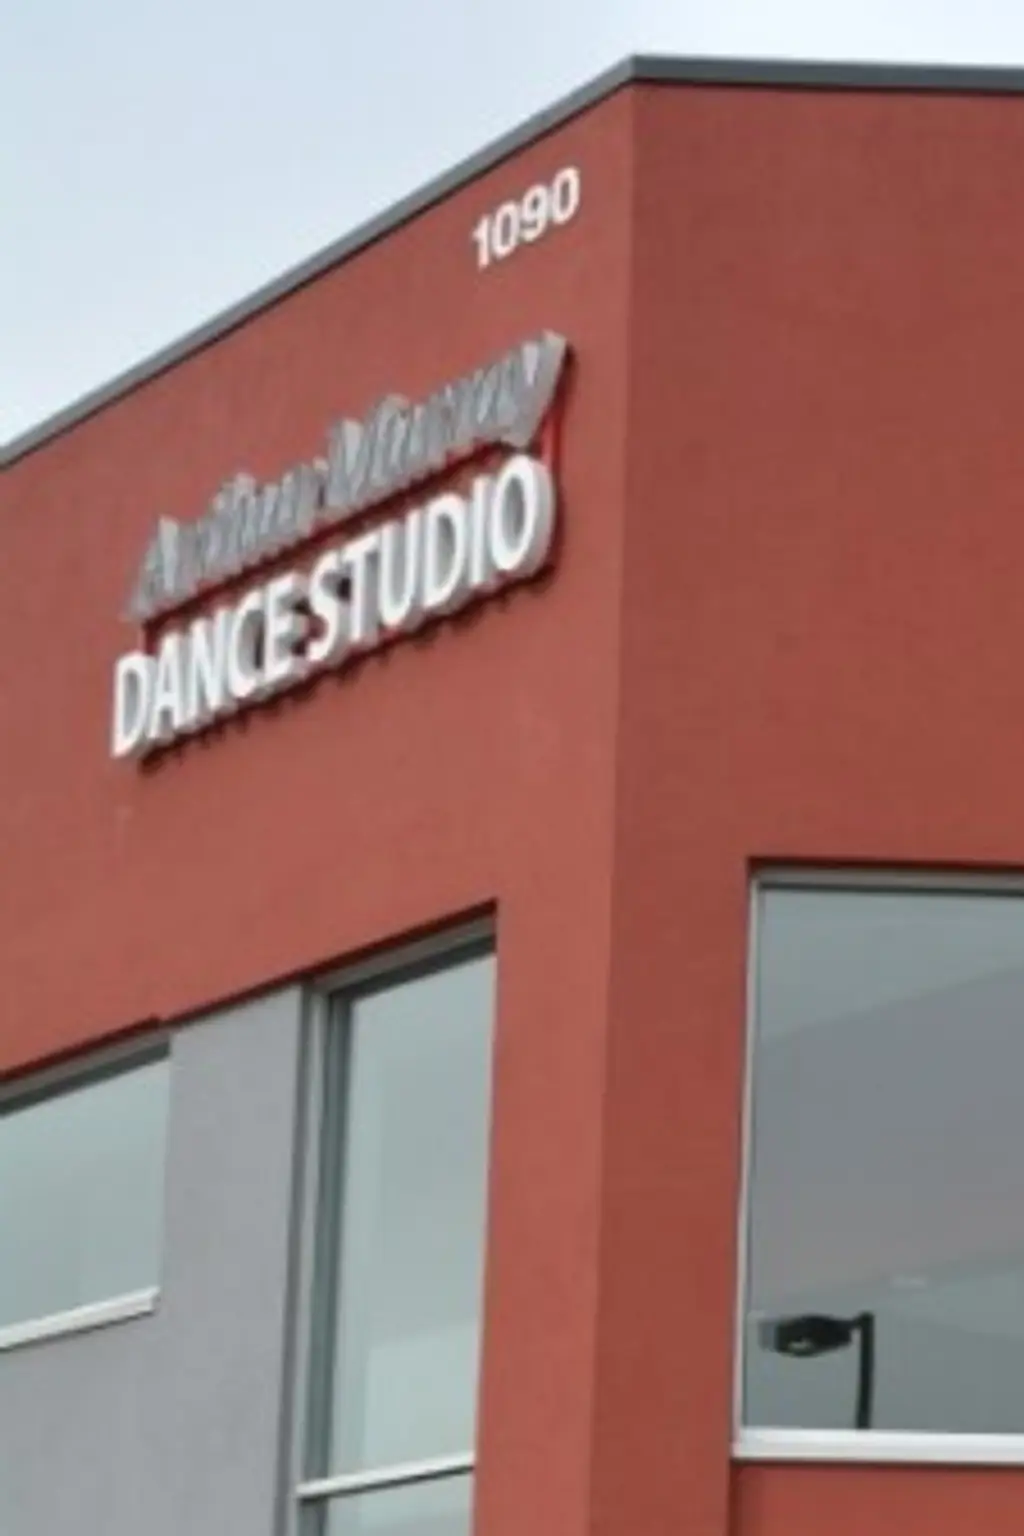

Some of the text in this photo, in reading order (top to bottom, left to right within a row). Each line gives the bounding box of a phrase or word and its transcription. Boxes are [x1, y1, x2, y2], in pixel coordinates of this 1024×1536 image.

[473, 166, 580, 267] 1090
[111, 452, 557, 758] DANCE STUDIO
